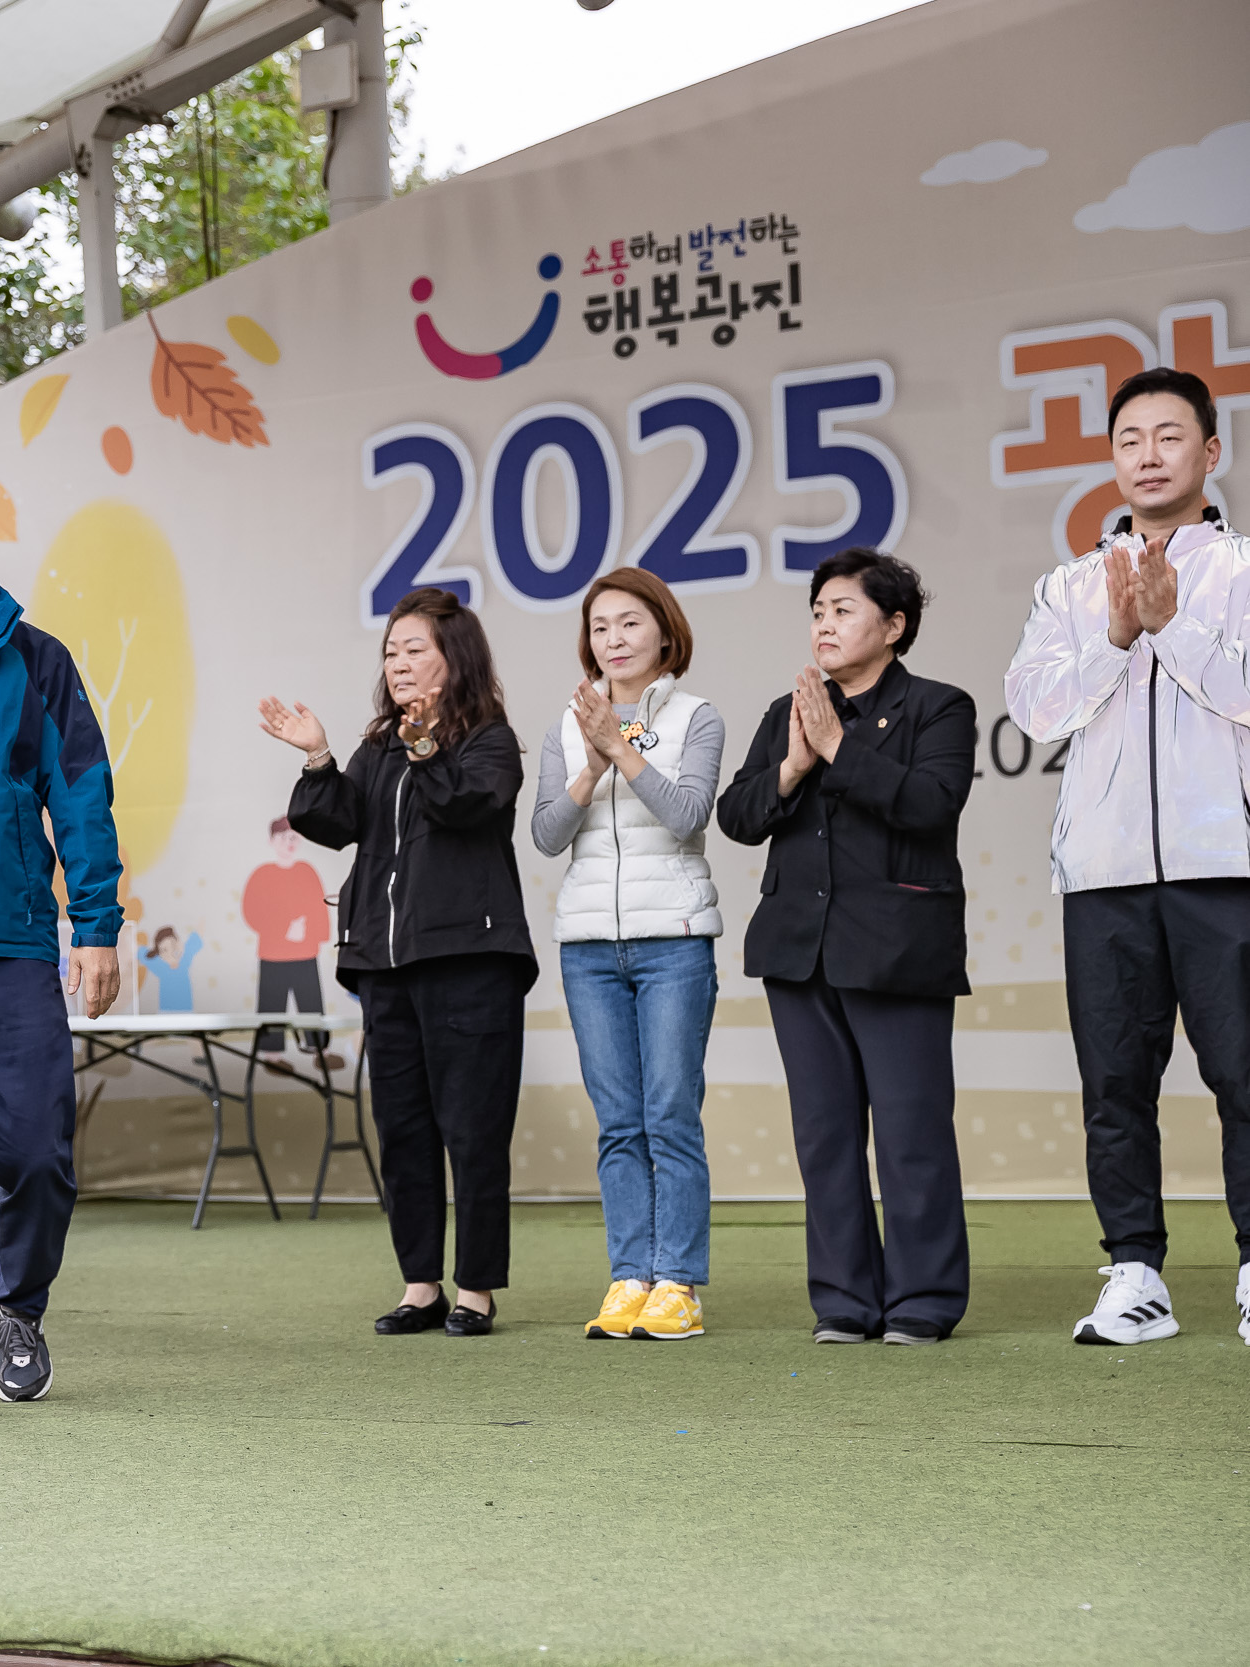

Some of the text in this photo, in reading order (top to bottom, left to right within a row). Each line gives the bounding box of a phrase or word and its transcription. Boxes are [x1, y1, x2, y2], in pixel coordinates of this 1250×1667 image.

[581, 212, 800, 286] 소통하며 발전하는
[582, 261, 803, 358] 행복광진
[367, 372, 897, 618] 2025
